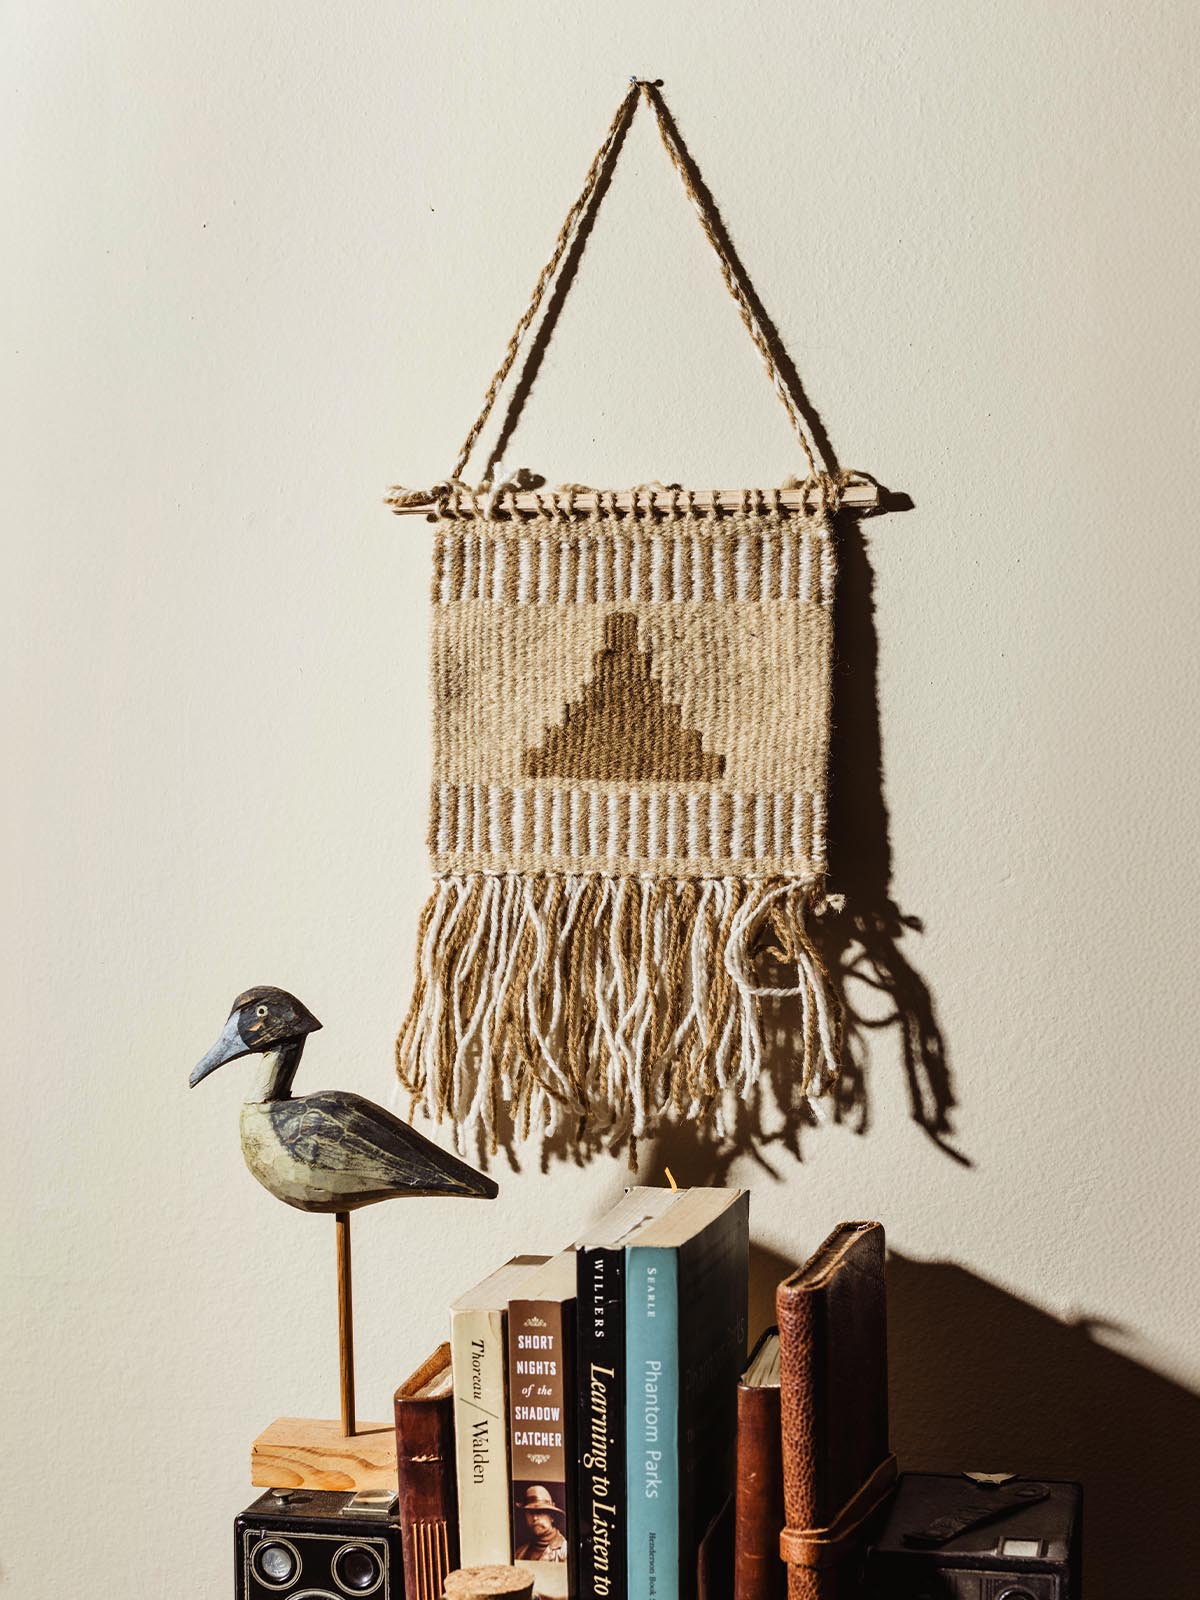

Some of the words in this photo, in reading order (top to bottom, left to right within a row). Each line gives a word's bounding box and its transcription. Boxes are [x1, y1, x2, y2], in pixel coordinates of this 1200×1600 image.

[594, 1259, 605, 1338] WILLERS
[647, 1267, 657, 1318] SEARLE
[518, 1335, 554, 1350] SHORT
[471, 1339, 485, 1401] Thoreau
[516, 1361, 557, 1376] NIGHTS
[521, 1384, 535, 1398] of
[537, 1384, 553, 1396] the
[645, 1360, 662, 1442] Phantom
[515, 1406, 561, 1422] SHADOW
[583, 1362, 615, 1472] Learning
[472, 1420, 490, 1484] Walden
[514, 1431, 562, 1447] CATCHER
[592, 1475, 611, 1497] to
[645, 1450, 662, 1498] Parks
[592, 1499, 617, 1572] Listen
[648, 1532, 657, 1575] Henderson
[593, 1575, 612, 1597] to
[648, 1576, 657, 1596] Book
